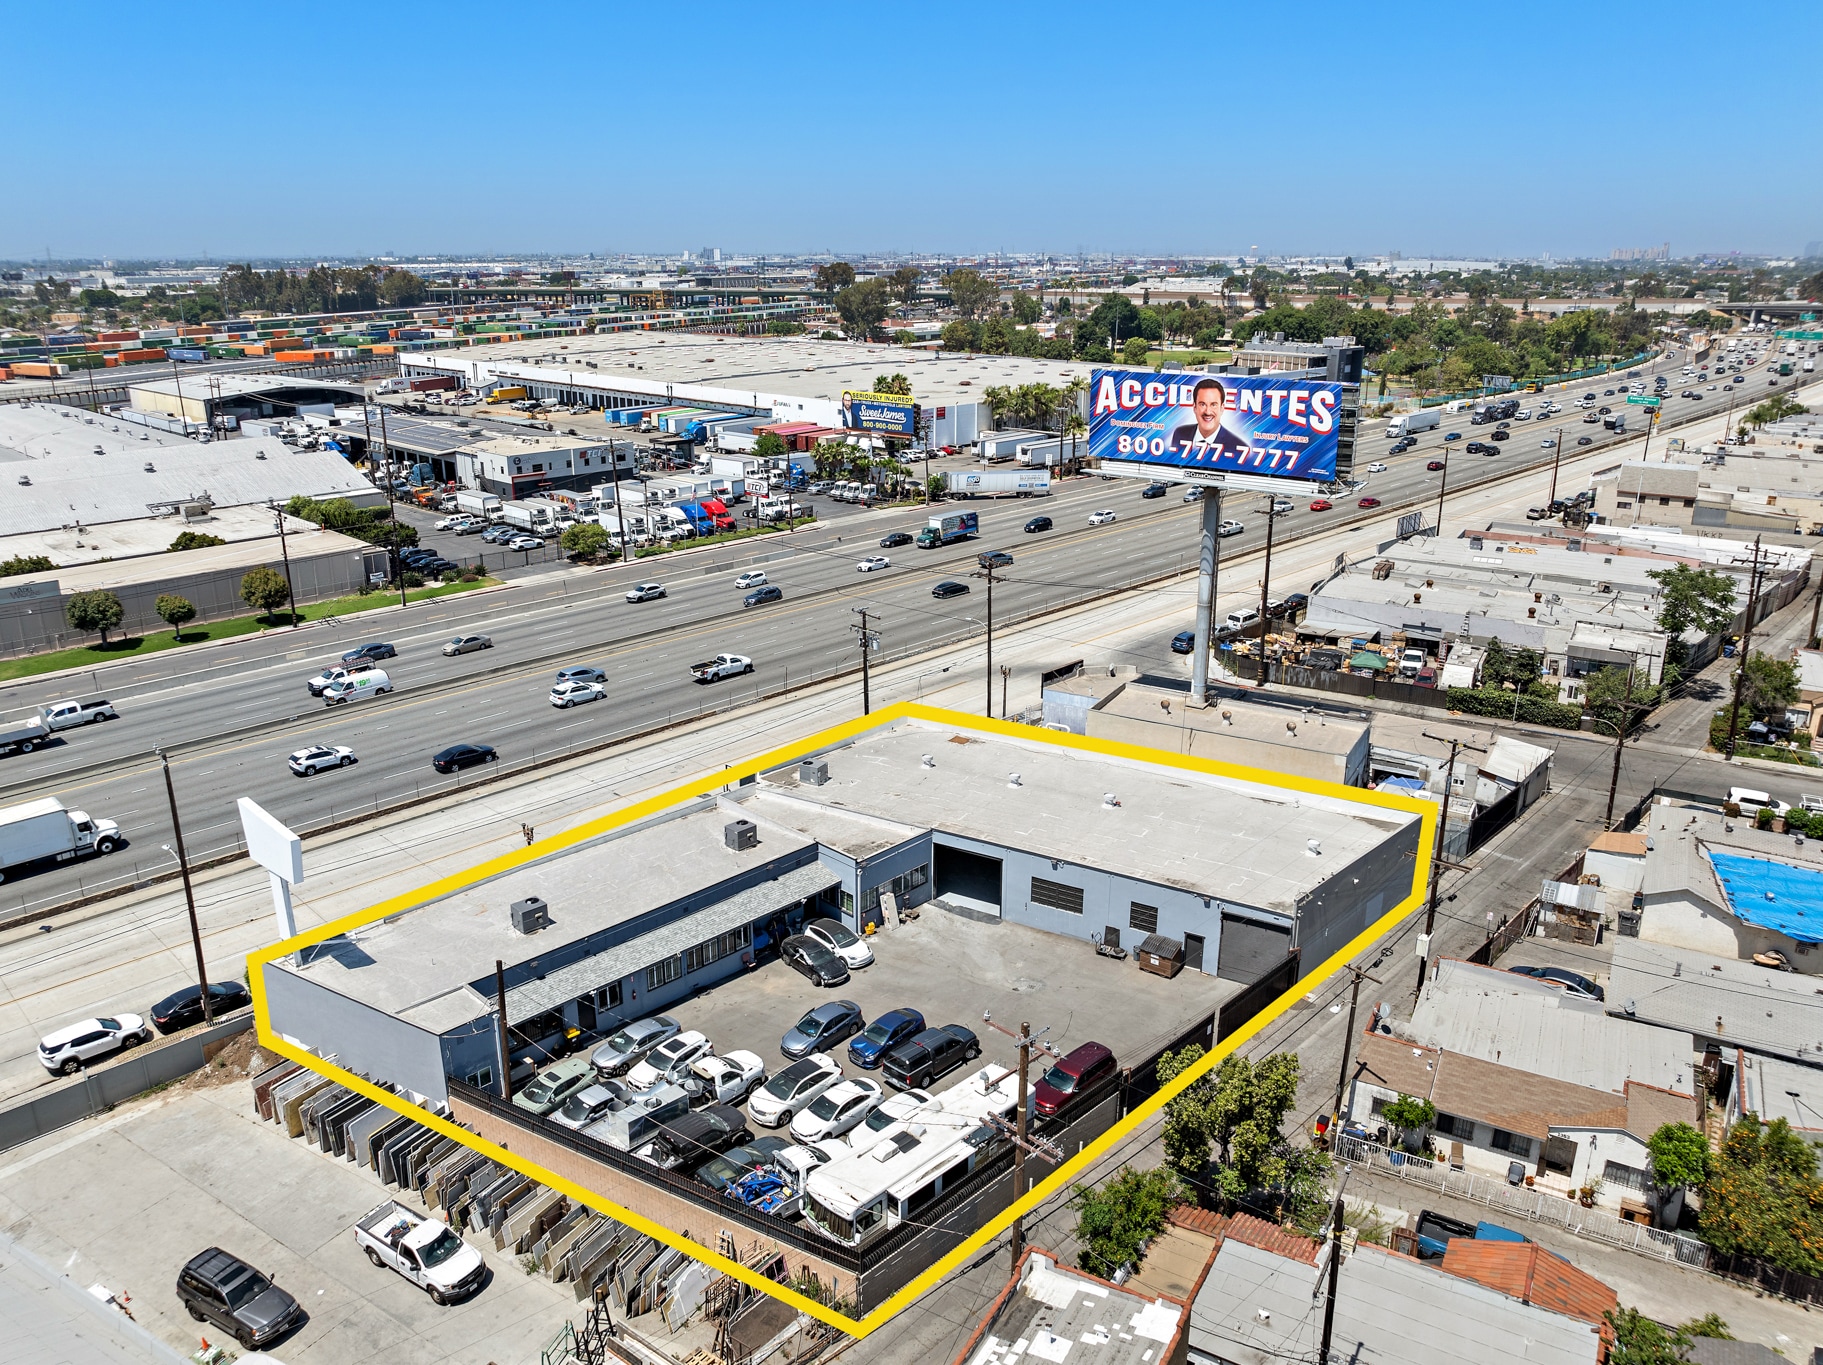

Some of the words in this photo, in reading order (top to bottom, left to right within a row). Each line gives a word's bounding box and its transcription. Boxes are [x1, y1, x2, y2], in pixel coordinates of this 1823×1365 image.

[852, 392, 882, 401] SERIOUSLY
[884, 396, 913, 404] INJURED?
[1094, 375, 1335, 435] ACCIDENTES
[859, 405, 881, 418] Sweet
[863, 420, 903, 431] 800-900-0000
[1110, 418, 1147, 429] DOMINGUEZ
[1148, 421, 1165, 430] FIRM
[1253, 431, 1277, 441] INJURY
[1277, 433, 1309, 443] LAWYERS
[1118, 434, 1300, 471] 800-777-7777
[751, 483, 762, 492] TCI
